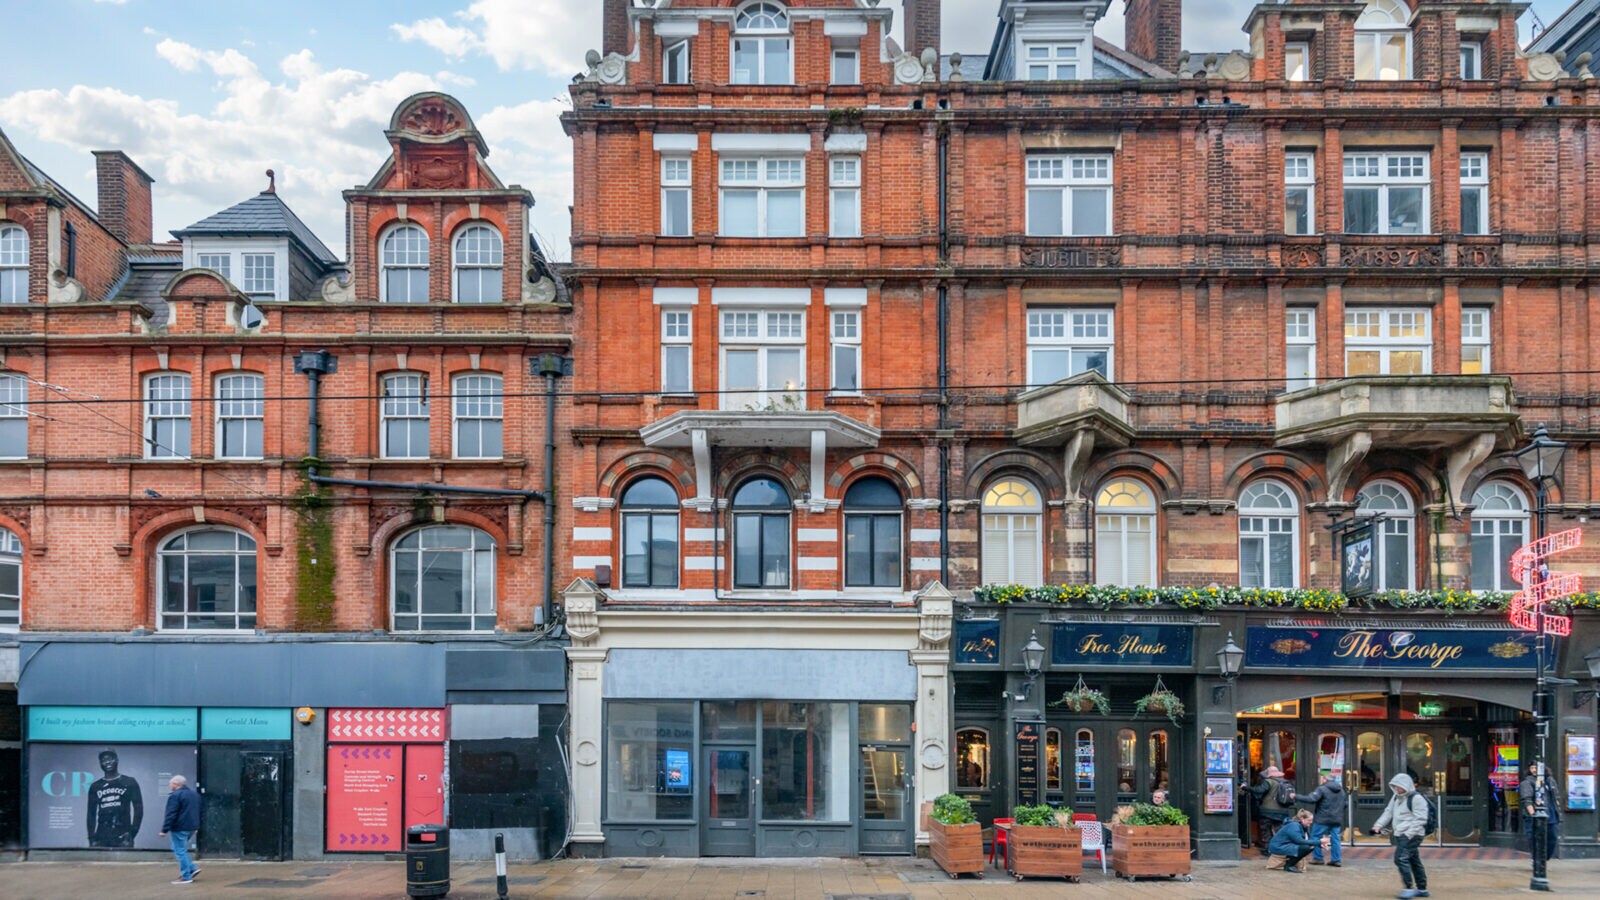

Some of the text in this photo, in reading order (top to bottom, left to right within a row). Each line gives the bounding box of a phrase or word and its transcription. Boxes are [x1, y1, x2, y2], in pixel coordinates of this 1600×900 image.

[1036, 251, 1108, 267] JUBILEE
[1299, 250, 1487, 266] A 1897 D
[1075, 633, 1168, 655] Free House
[1334, 630, 1463, 668] The George
